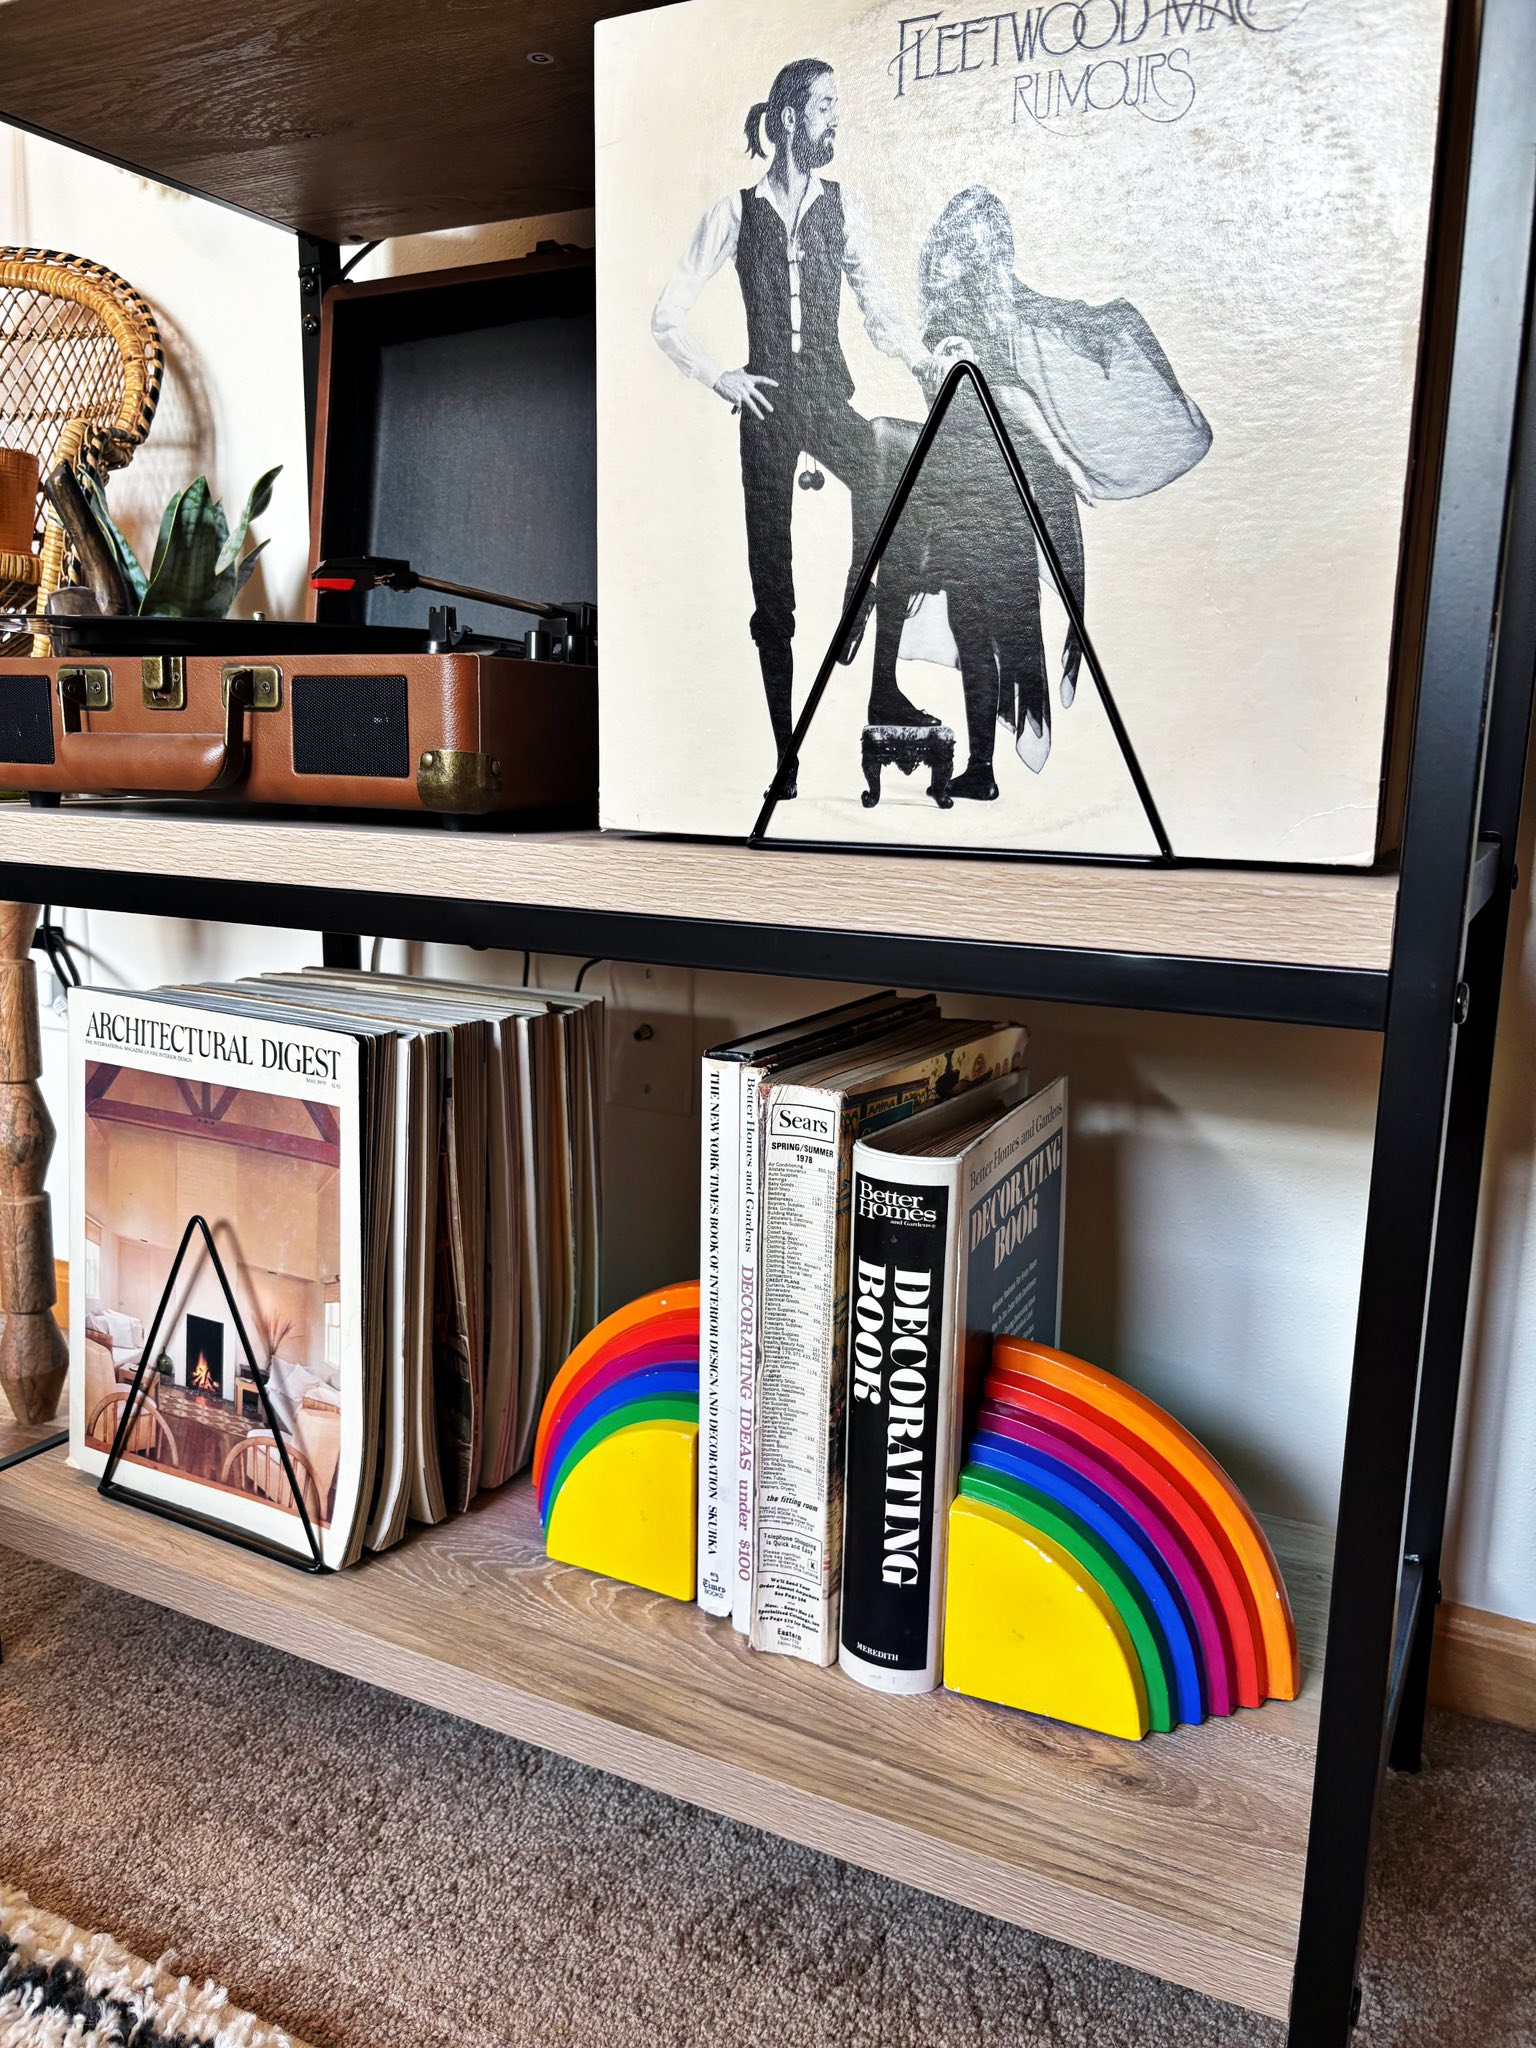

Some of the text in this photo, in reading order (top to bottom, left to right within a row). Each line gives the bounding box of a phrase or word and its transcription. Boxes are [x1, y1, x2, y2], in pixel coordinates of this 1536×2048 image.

[887, 0, 1149, 100] FLEETWOOD
[1011, 48, 1195, 136] RUMOURS
[86, 1011, 341, 1080] ARCHITECTURAL DIGEST
[779, 1109, 828, 1134] Sears
[771, 1142, 834, 1158] SPRING/SUMMER
[796, 1154, 813, 1164] 1978
[969, 1101, 1062, 1191] Better Homes and Gardens
[744, 1078, 756, 1254] Better Homes and Gardens
[859, 1180, 924, 1209] Better
[971, 1134, 1062, 1253] DECORATING
[859, 1197, 937, 1222] Homes
[993, 1192, 1038, 1271] BOOK
[707, 1071, 720, 1555] THE NEW YORK TIMES BOOK OF INTERIOR DESIGN AND DECORATION SKURKA
[853, 1255, 886, 1405] BOOK
[738, 1264, 754, 1582] DECORATING IDEAS under $100
[882, 1265, 931, 1588] DECORATING
[781, 1496, 801, 1507] fitting
[803, 1502, 818, 1512] room
[764, 1533, 816, 1551] Telephone Shopping
[802, 1545, 813, 1554] Easy
[704, 1588, 724, 1599] BOOKS
[796, 1589, 819, 1601] Anywhere
[778, 1628, 801, 1641] Eastern
[856, 1641, 899, 1661] MEREDITH
